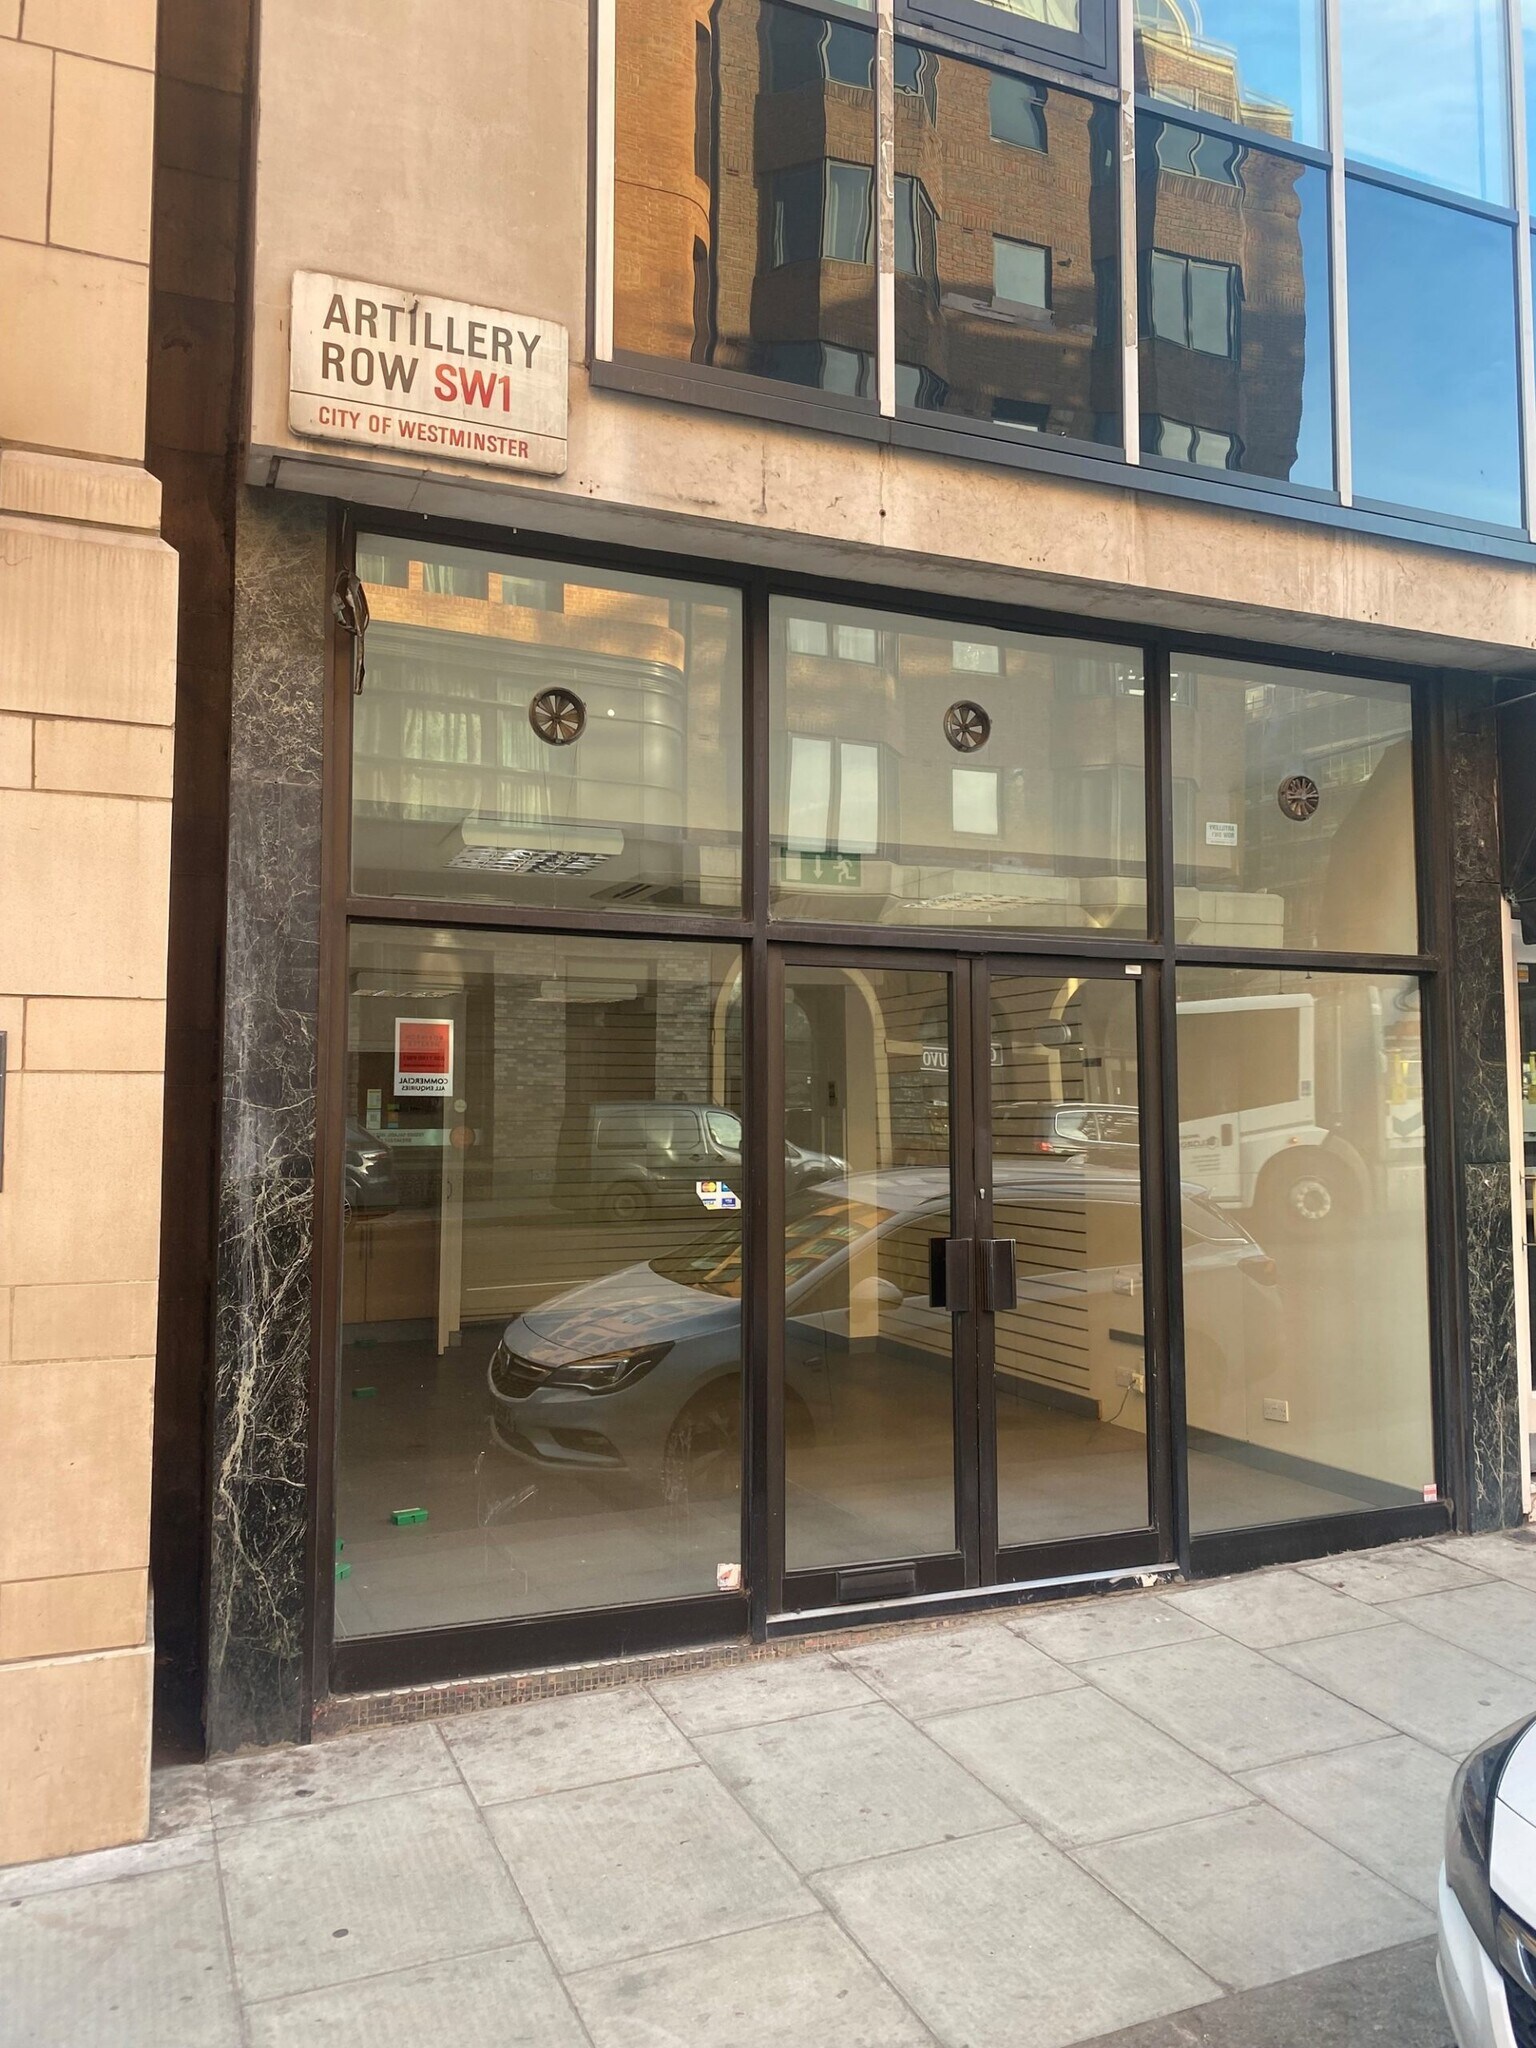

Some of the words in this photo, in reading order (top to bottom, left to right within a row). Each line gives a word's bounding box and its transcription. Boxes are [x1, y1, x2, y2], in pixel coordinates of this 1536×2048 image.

[322, 293, 542, 369] ARTILLERY
[321, 341, 419, 394] ROW
[434, 363, 511, 412] SW1
[318, 406, 361, 430] CITY
[368, 414, 392, 434] OF
[398, 419, 529, 459] WESTMINSTER
